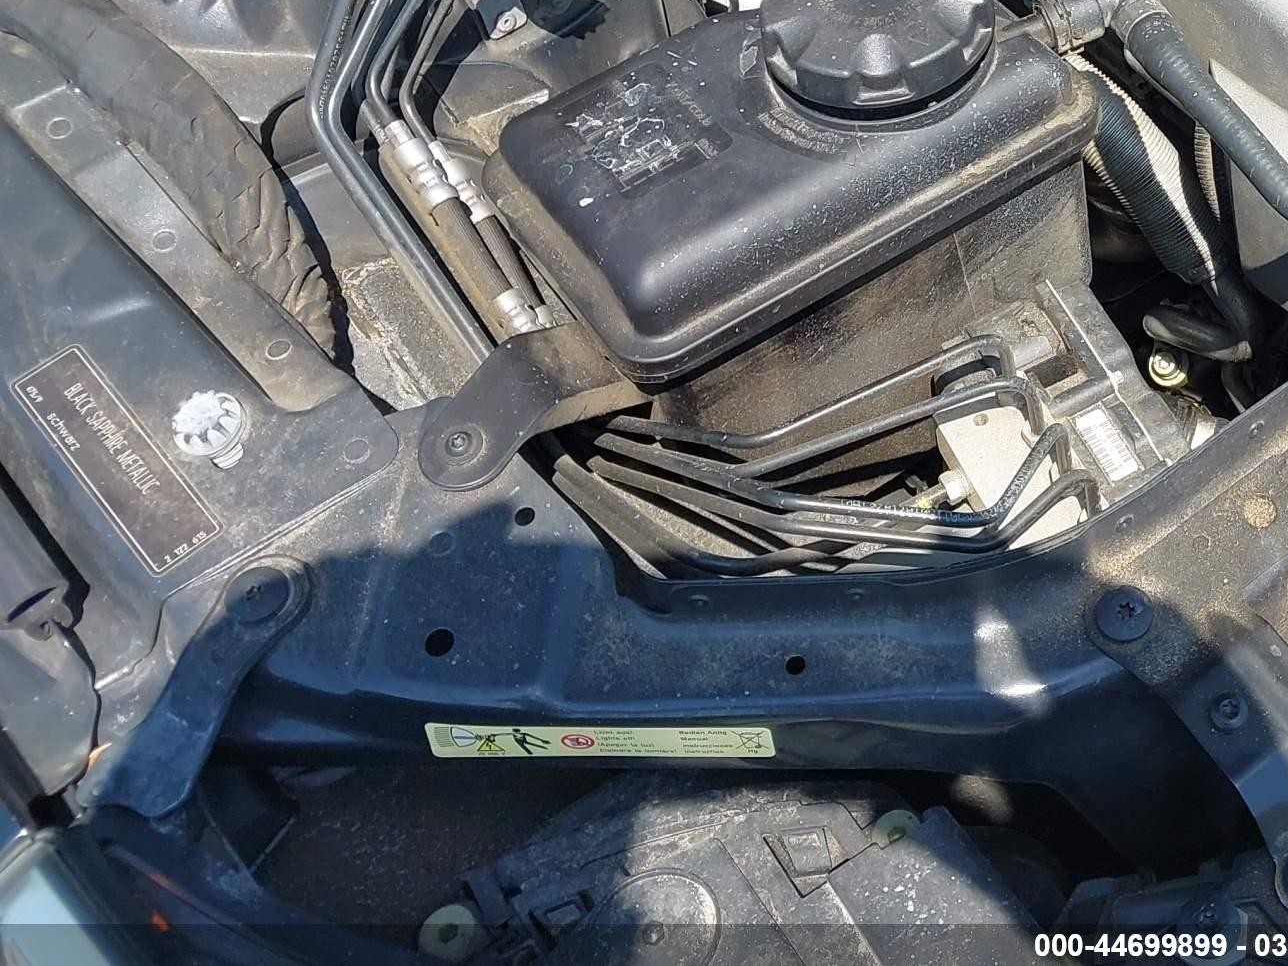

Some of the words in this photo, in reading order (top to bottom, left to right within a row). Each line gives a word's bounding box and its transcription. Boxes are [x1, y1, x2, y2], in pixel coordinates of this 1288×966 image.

[45, 409, 84, 453] schwarz
[61, 381, 98, 417] BLACK
[83, 408, 128, 456] SAPPHIRE
[113, 446, 161, 497] METALLIC
